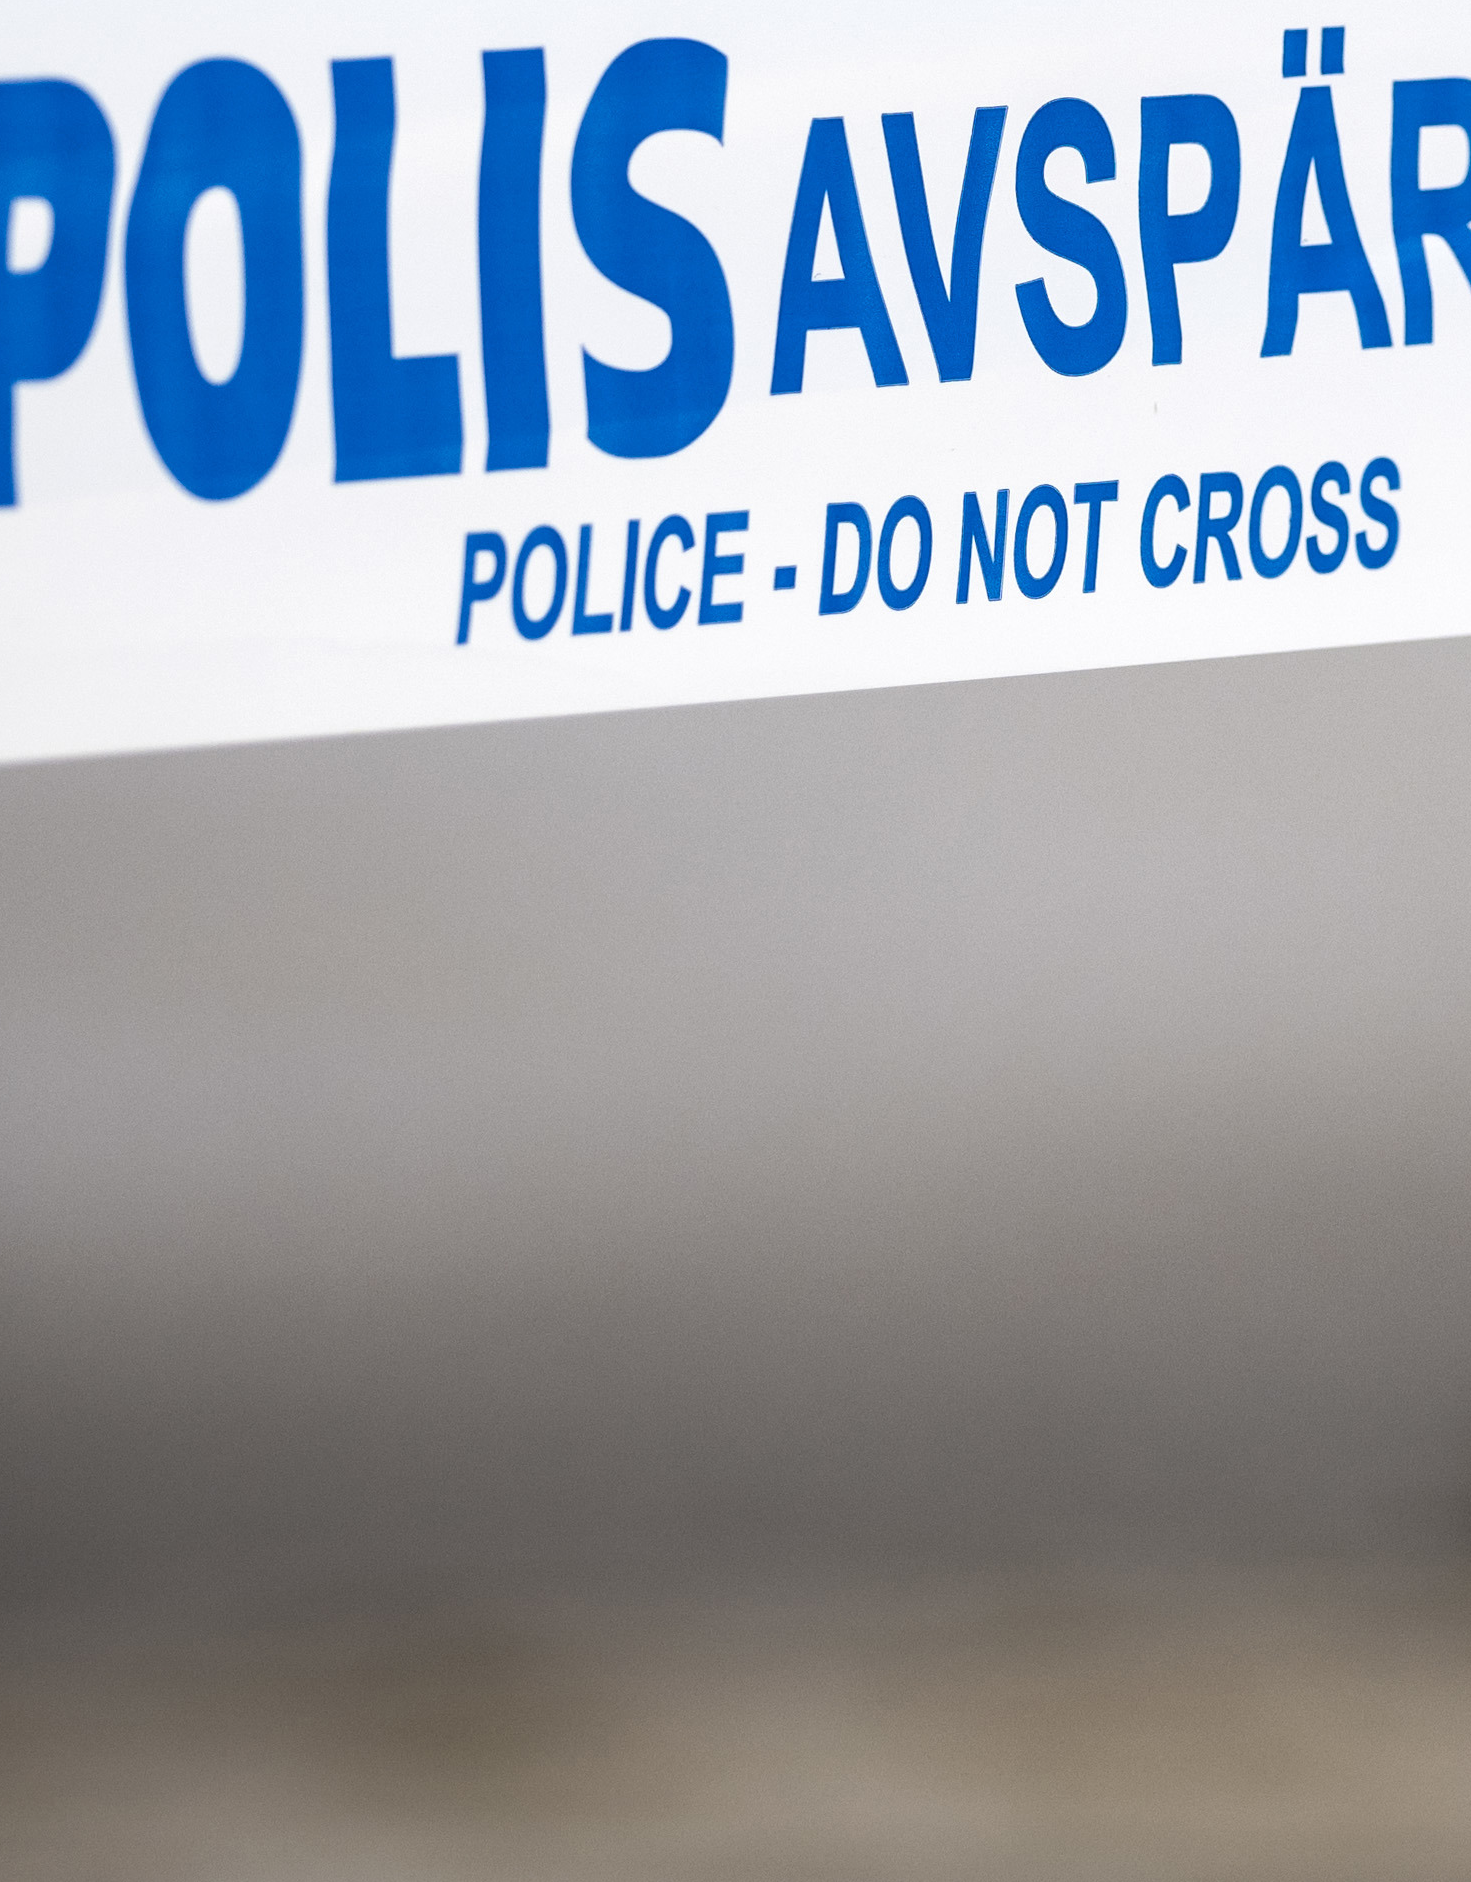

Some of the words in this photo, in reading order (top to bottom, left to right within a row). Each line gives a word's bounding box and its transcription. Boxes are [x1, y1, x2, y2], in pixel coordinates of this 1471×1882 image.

[455, 510, 750, 646] POLICE
[772, 565, 798, 591] -
[818, 495, 933, 617] DO
[955, 479, 1120, 605] NOT
[1139, 456, 1402, 589] CROSS
